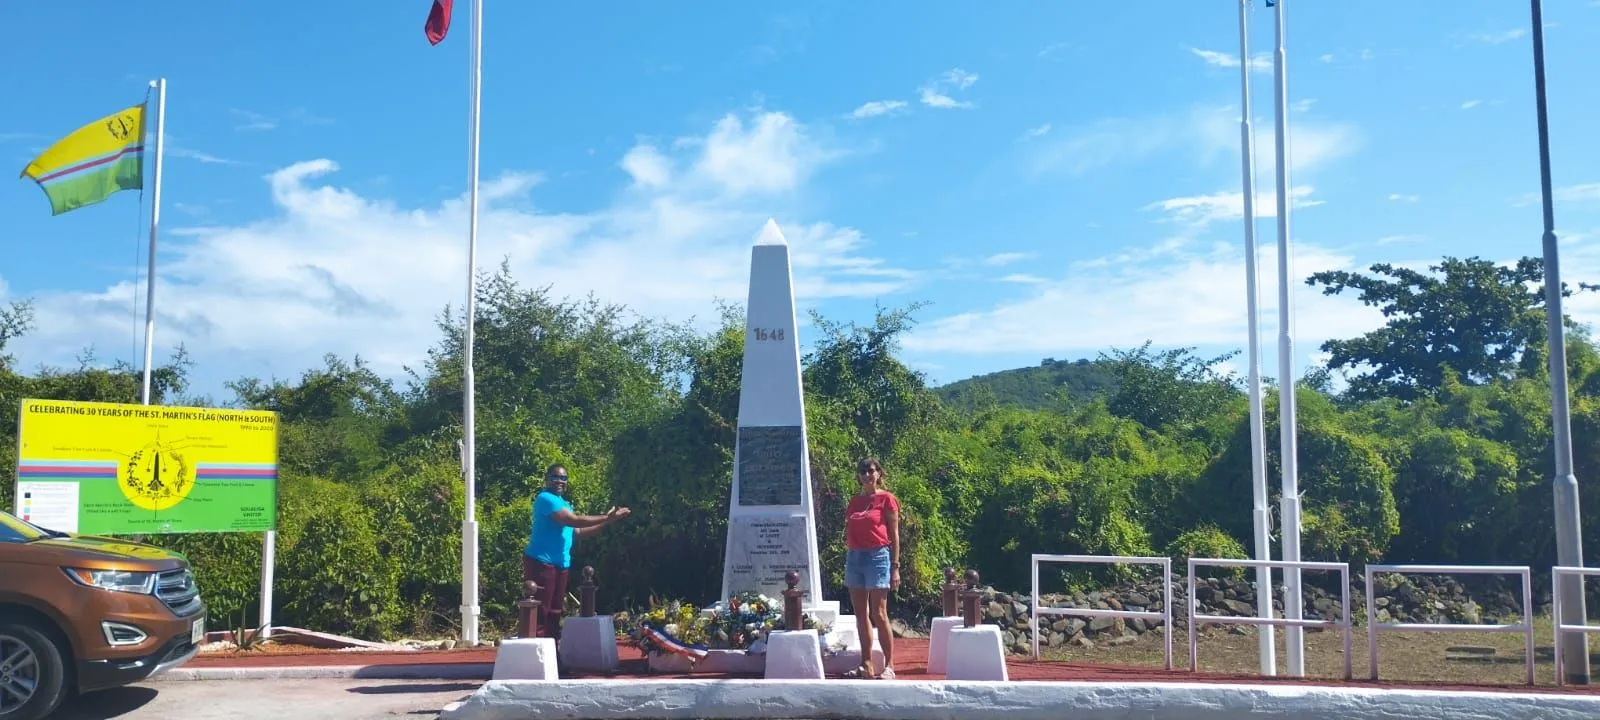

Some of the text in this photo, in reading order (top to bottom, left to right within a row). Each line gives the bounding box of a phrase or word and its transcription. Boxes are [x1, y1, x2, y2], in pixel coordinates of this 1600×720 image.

[753, 327, 785, 341] 1648
[29, 404, 85, 415] CELEBRATING
[87, 407, 96, 416] 30
[97, 408, 121, 417] YEARS
[123, 409, 133, 417] OF
[134, 409, 149, 418] THE
[150, 410, 161, 418] ST.
[162, 411, 198, 420] MARTIN'S
[198, 412, 216, 421] FLAG
[216, 413, 243, 423] (NORTH
[250, 415, 276, 425] SOUTH)
